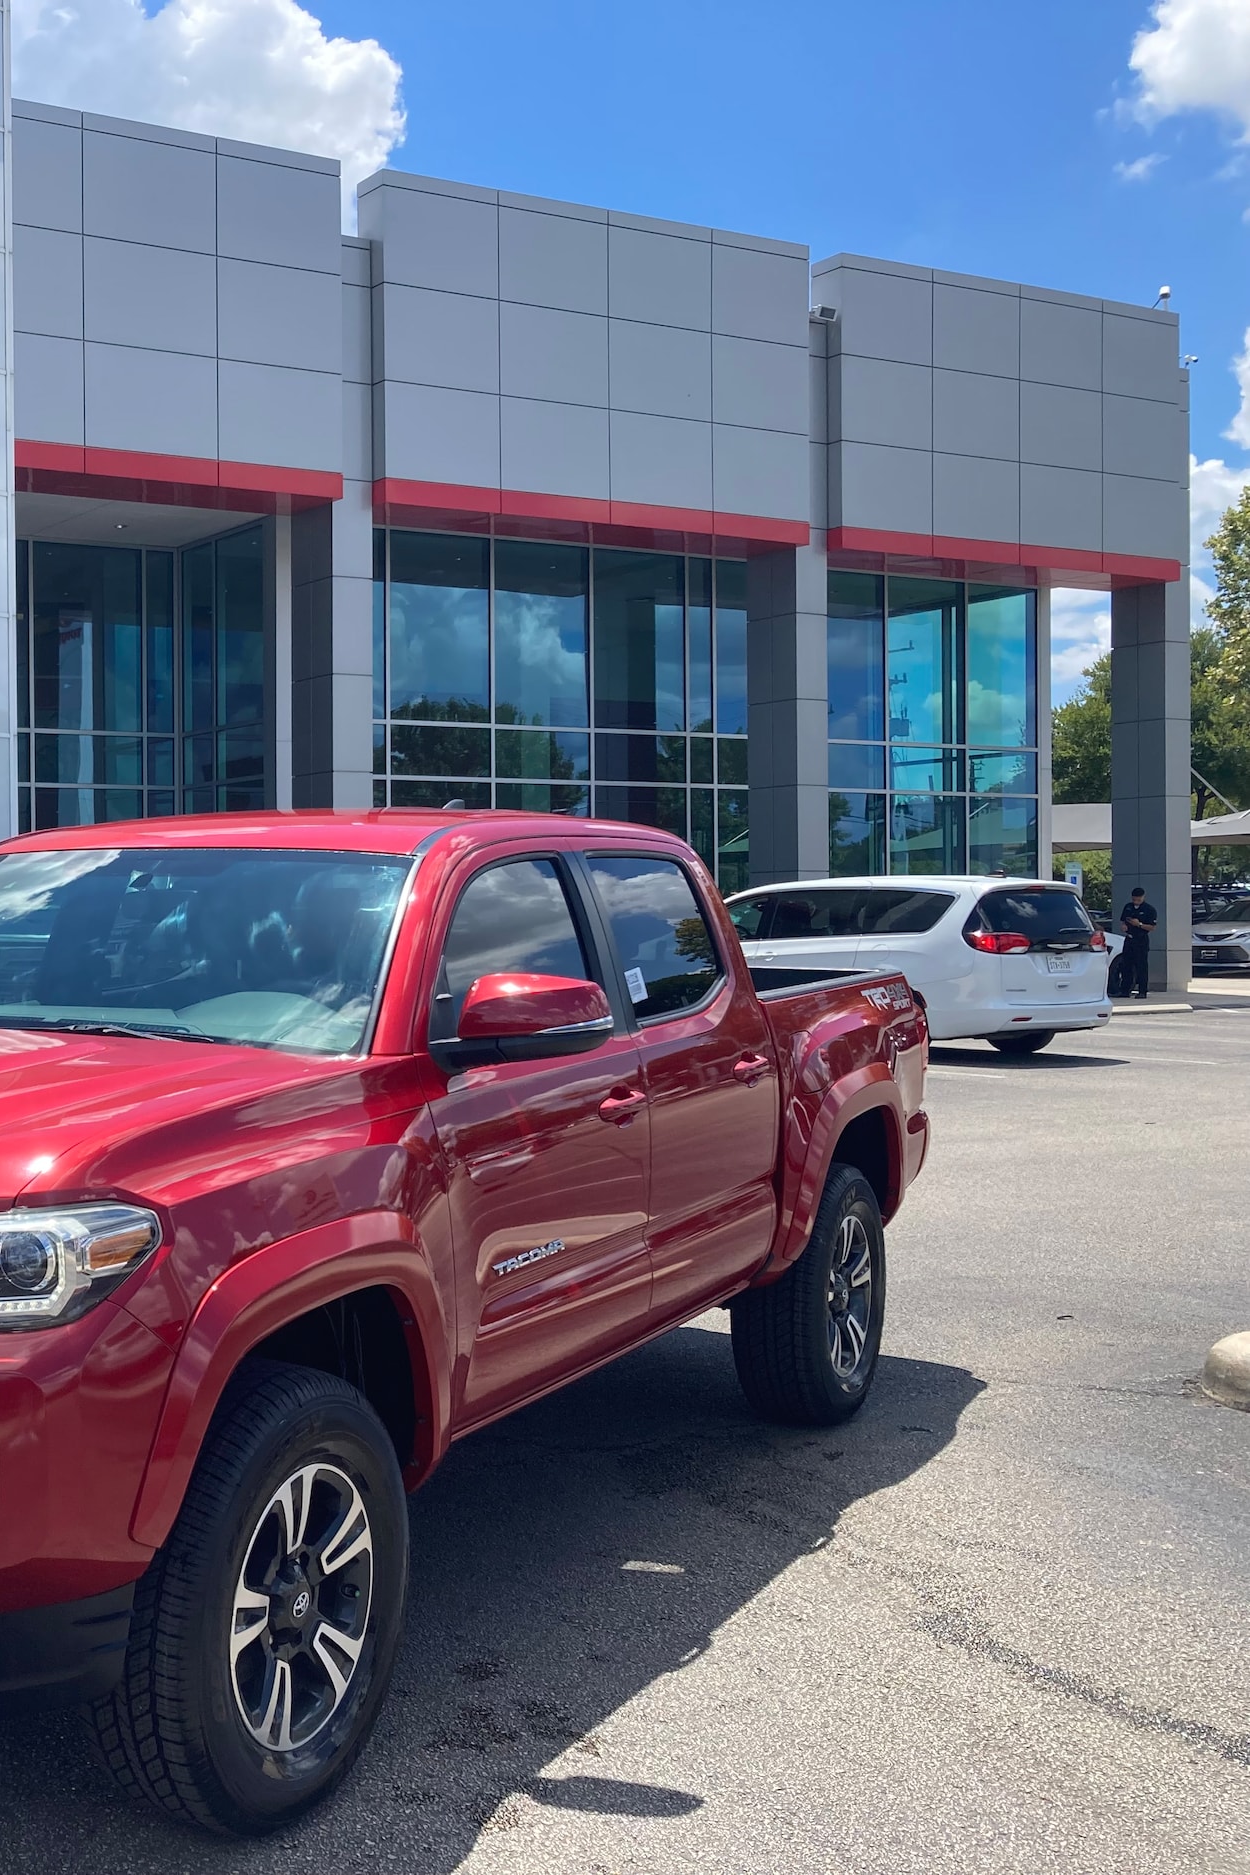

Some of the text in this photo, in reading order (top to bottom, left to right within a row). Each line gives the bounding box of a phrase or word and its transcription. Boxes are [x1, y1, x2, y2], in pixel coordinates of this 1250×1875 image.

[860, 986, 891, 1011] TRD
[892, 998, 911, 1011] SPORT
[492, 1238, 566, 1276] TACOMA
